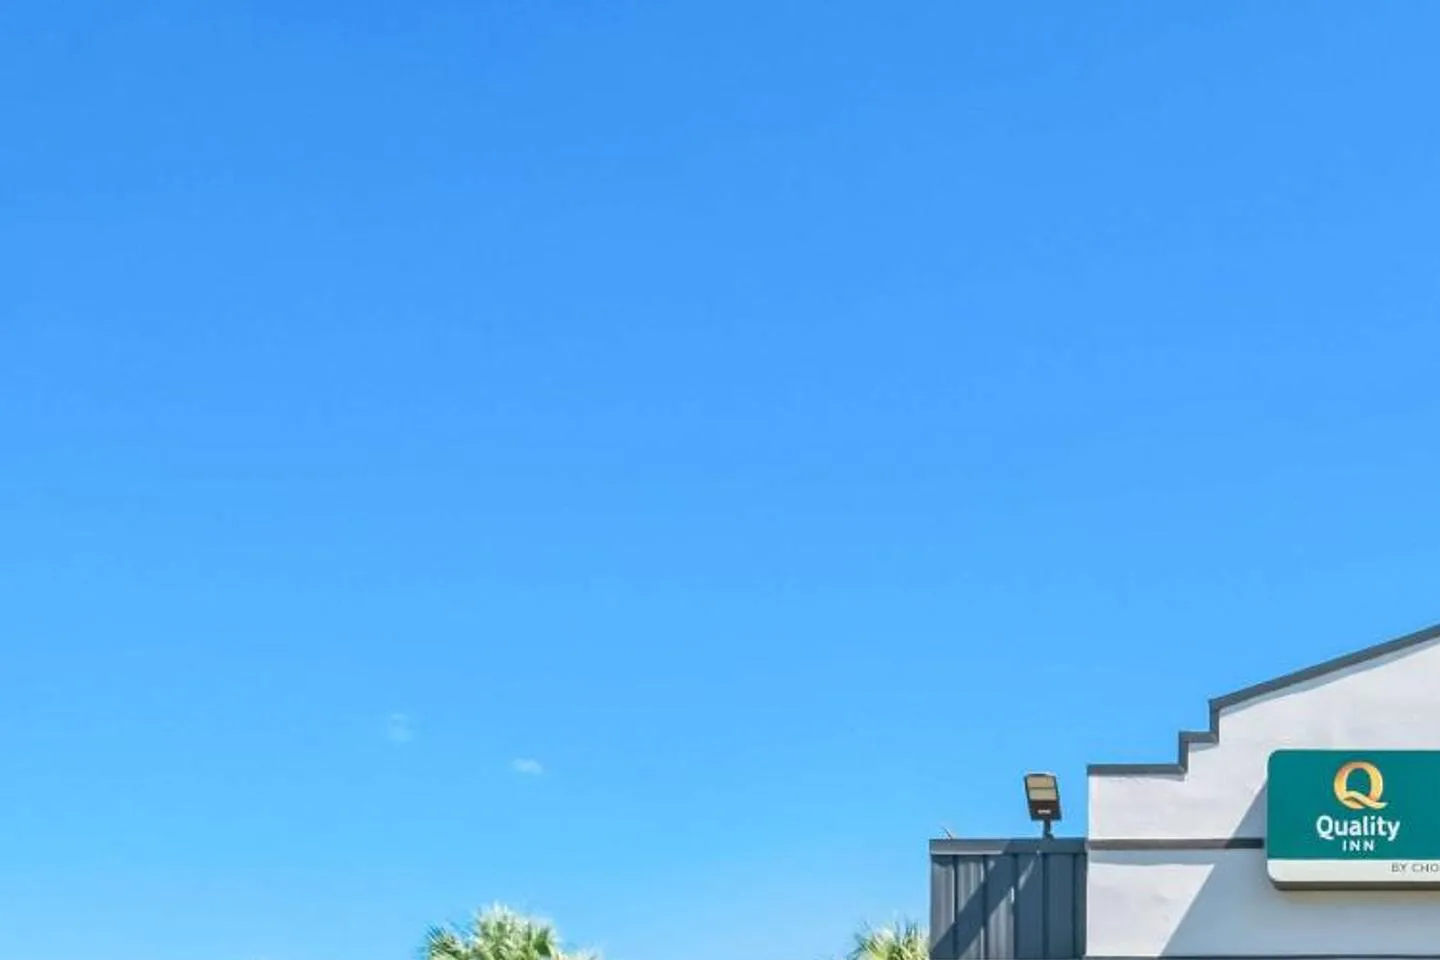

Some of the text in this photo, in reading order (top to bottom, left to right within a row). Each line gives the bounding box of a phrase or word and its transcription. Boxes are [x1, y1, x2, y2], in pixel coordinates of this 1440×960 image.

[1333, 761, 1387, 809] Q
[1316, 814, 1400, 842] Quality
[1342, 840, 1375, 852] INN
[1391, 863, 1407, 873] BY
